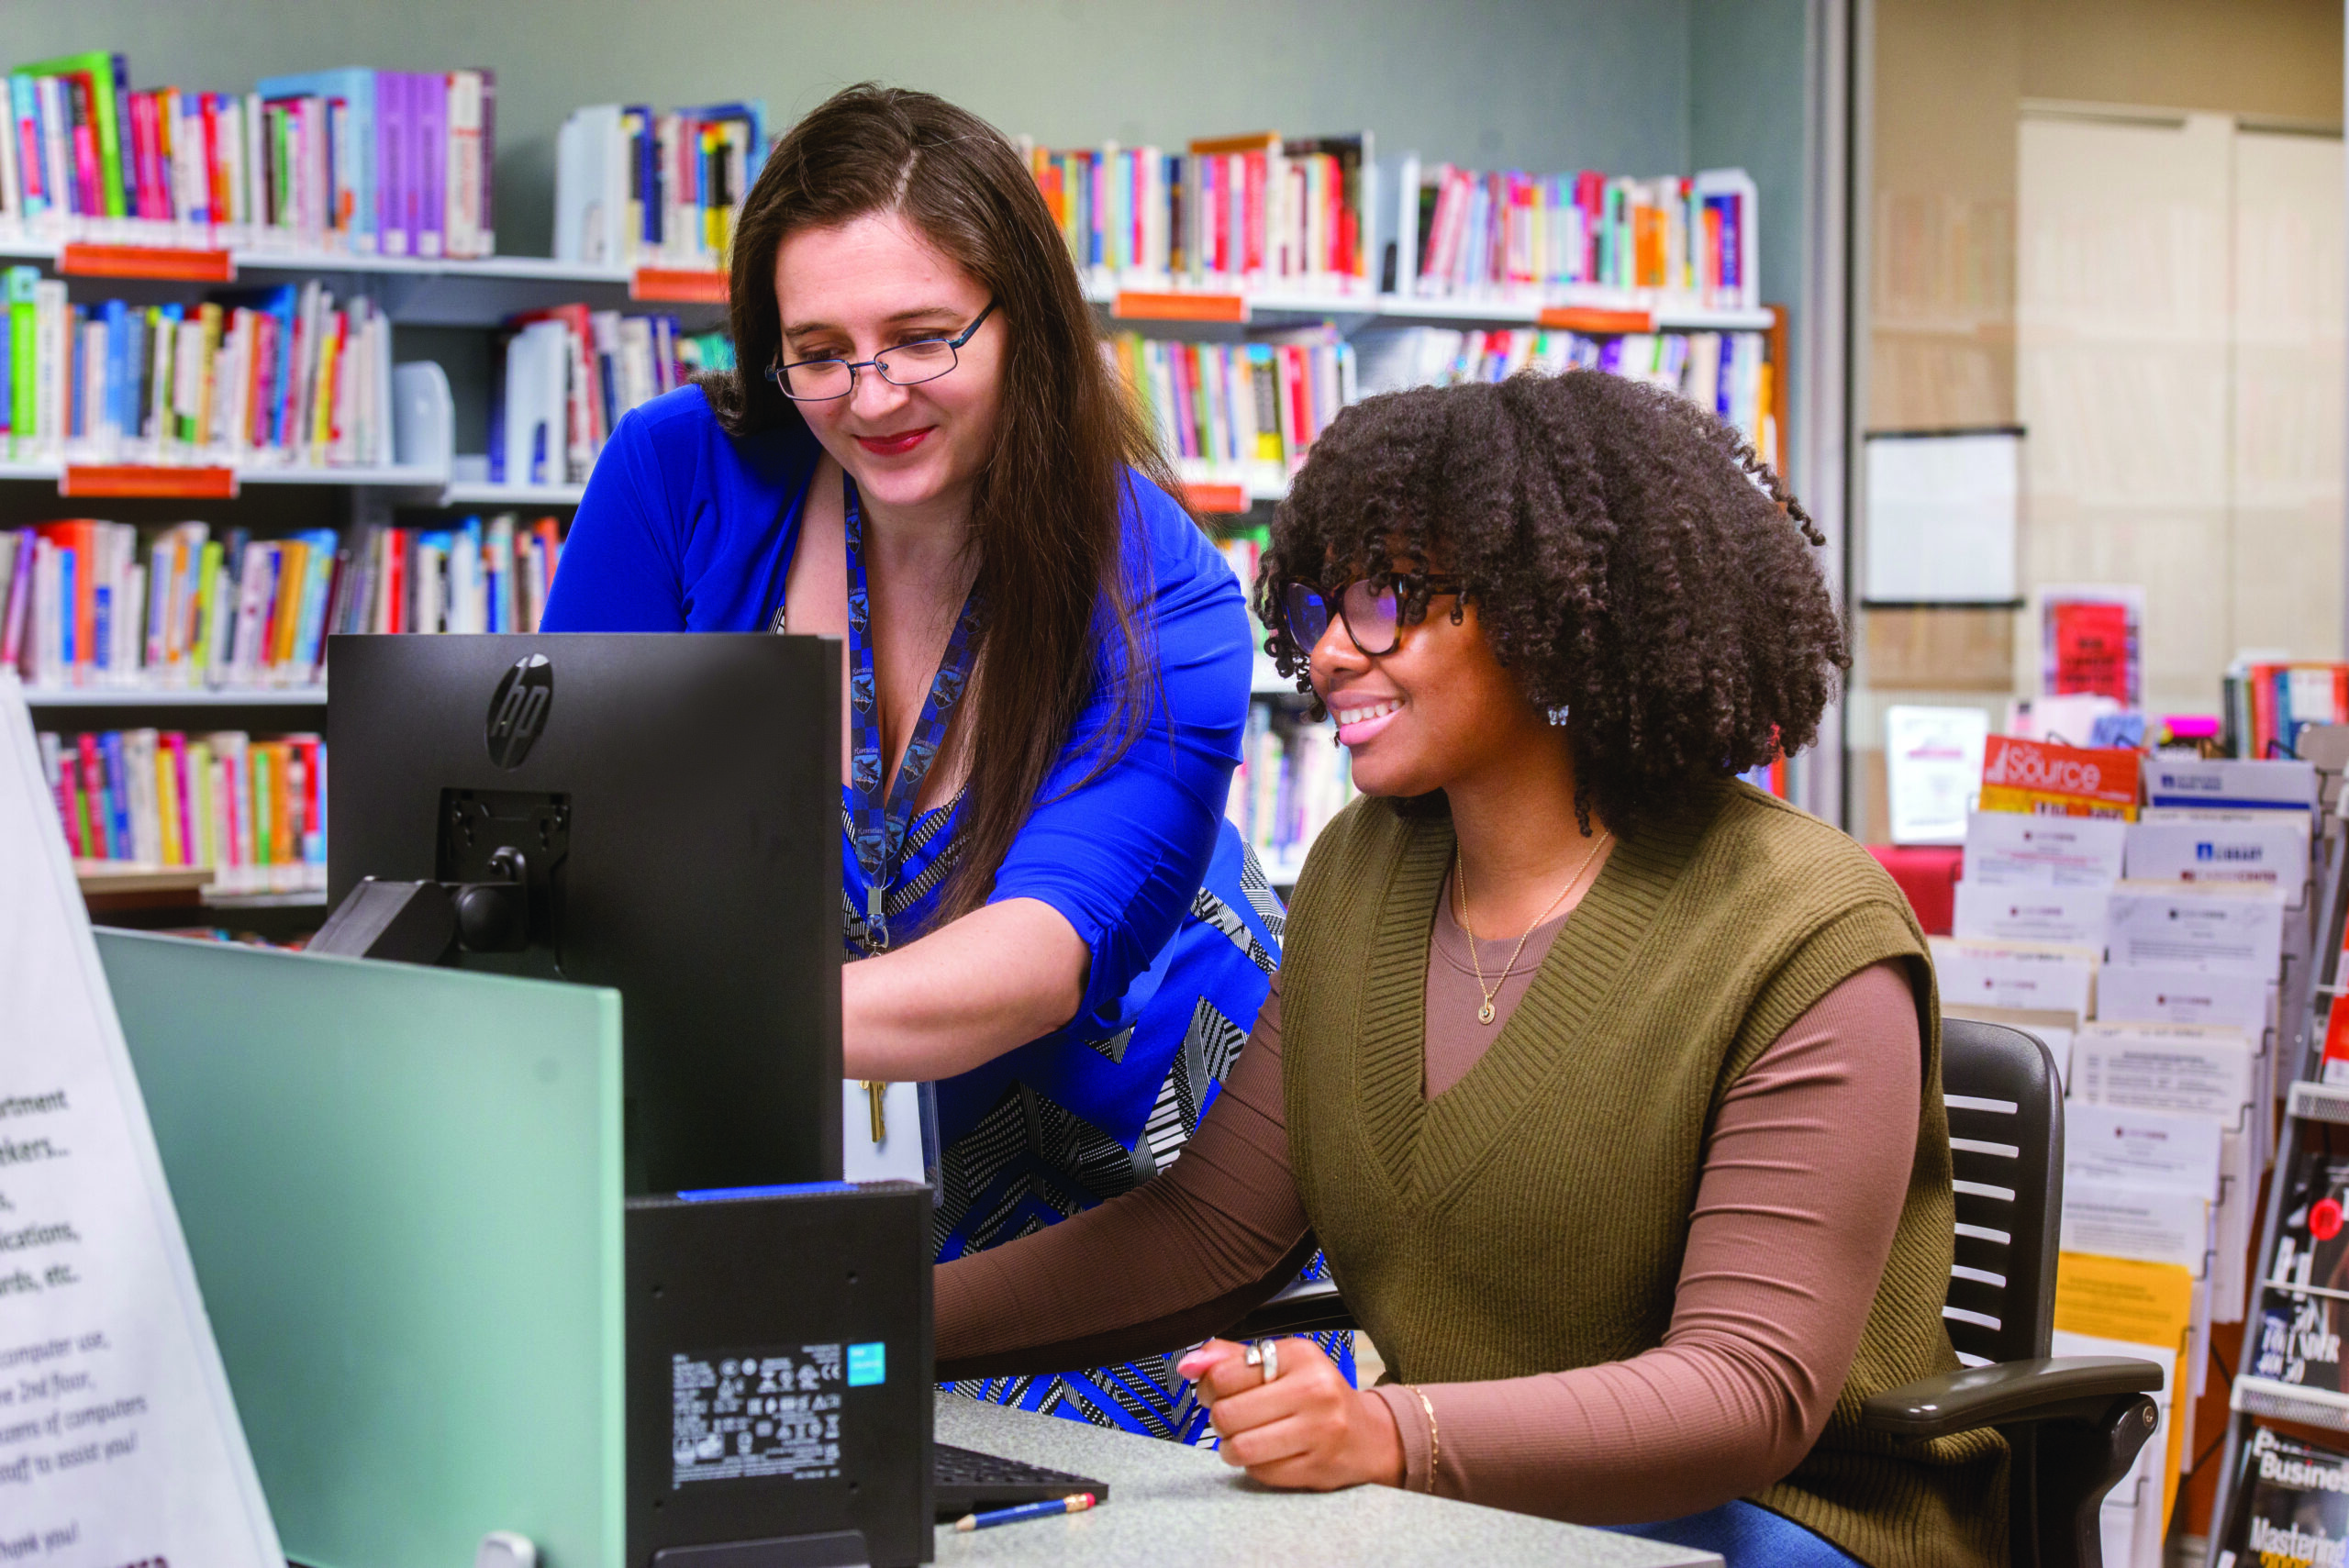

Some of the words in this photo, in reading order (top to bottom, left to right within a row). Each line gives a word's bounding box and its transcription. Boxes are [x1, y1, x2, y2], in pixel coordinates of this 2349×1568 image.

[489, 654, 551, 769] hp
[2008, 745, 2101, 792] Source
[64, 1395, 148, 1430] computers
